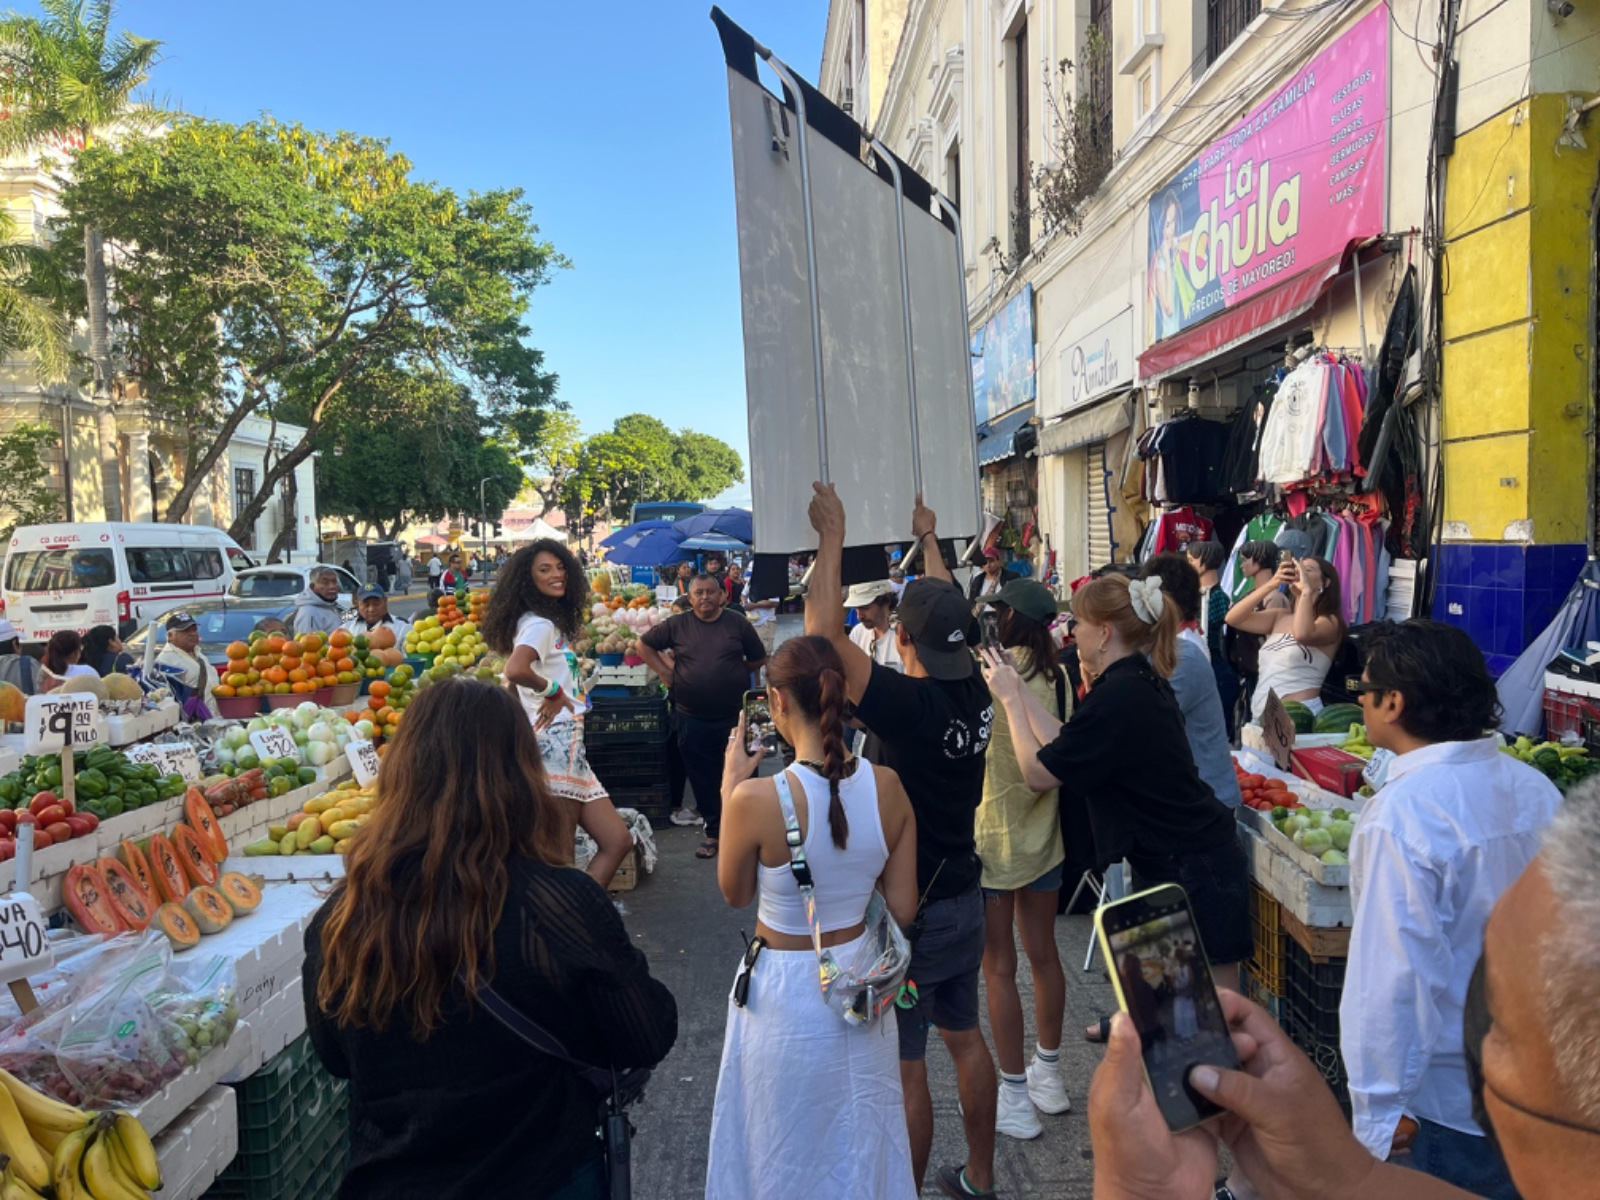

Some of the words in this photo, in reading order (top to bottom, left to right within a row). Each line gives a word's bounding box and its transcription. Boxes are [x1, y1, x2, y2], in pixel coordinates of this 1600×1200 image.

[1332, 68, 1371, 105] VESTIDOS
[1204, 144, 1226, 173] PARA
[1228, 122, 1253, 153] TODA
[1255, 109, 1269, 133] LA
[1271, 71, 1316, 119] FAMILIA
[1331, 95, 1363, 126] BLUSAS
[1330, 116, 1363, 147] SHORTS
[1330, 128, 1375, 167] BERMUDAS
[1224, 157, 1253, 210] La
[1329, 156, 1365, 187] CAMISAS
[1188, 158, 1301, 290] Chula
[1227, 277, 1240, 297] DE
[1242, 246, 1297, 289] MAYOREO!
[41, 700, 94, 714] TOMATE
[74, 729, 97, 742] KILO
